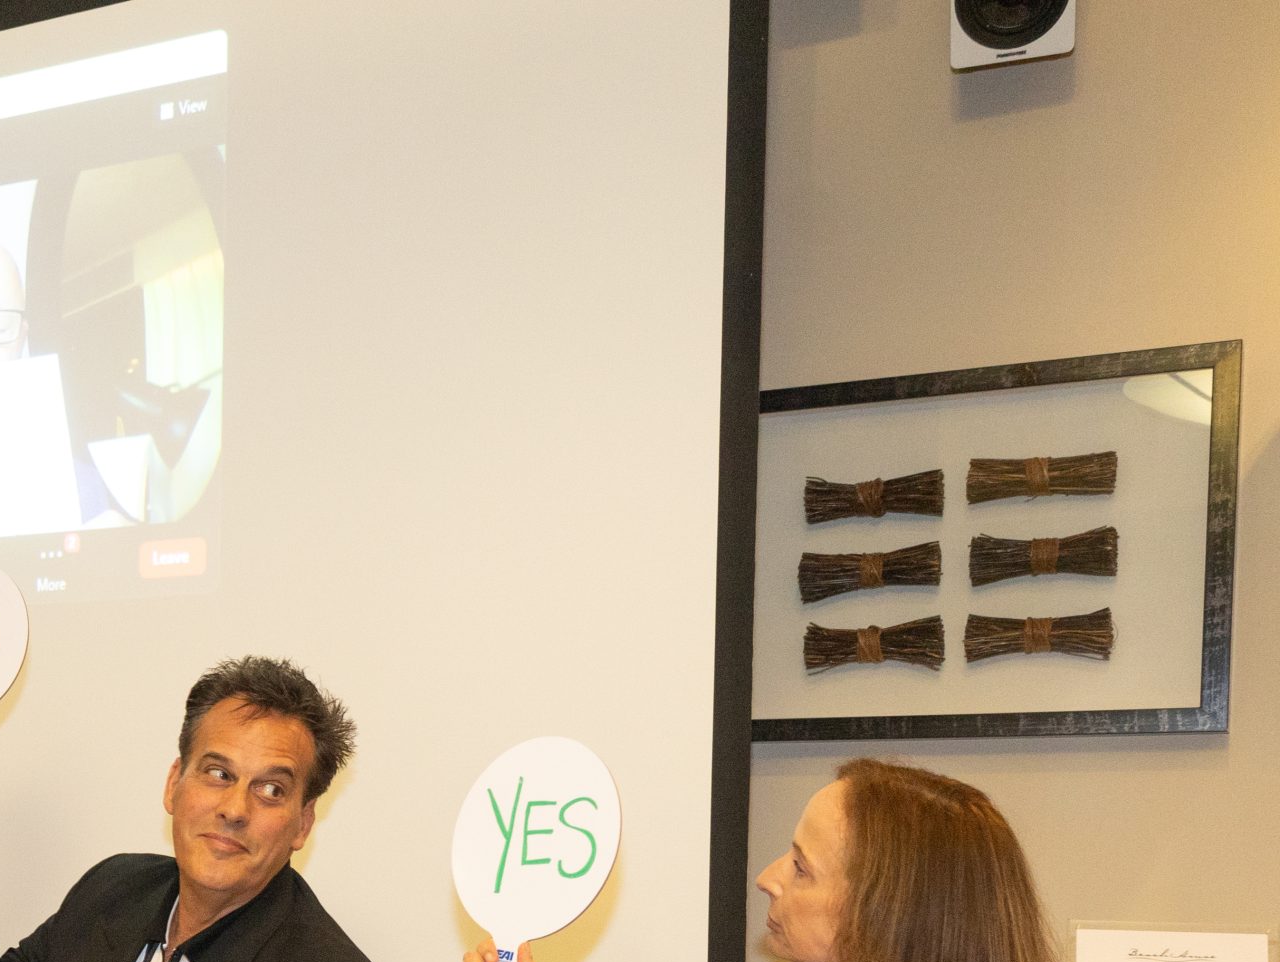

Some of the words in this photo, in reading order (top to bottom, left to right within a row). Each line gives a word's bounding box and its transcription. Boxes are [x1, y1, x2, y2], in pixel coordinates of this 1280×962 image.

[178, 99, 208, 115] View
[152, 549, 191, 566] Leave
[36, 577, 67, 593] More
[486, 776, 598, 894] YES
